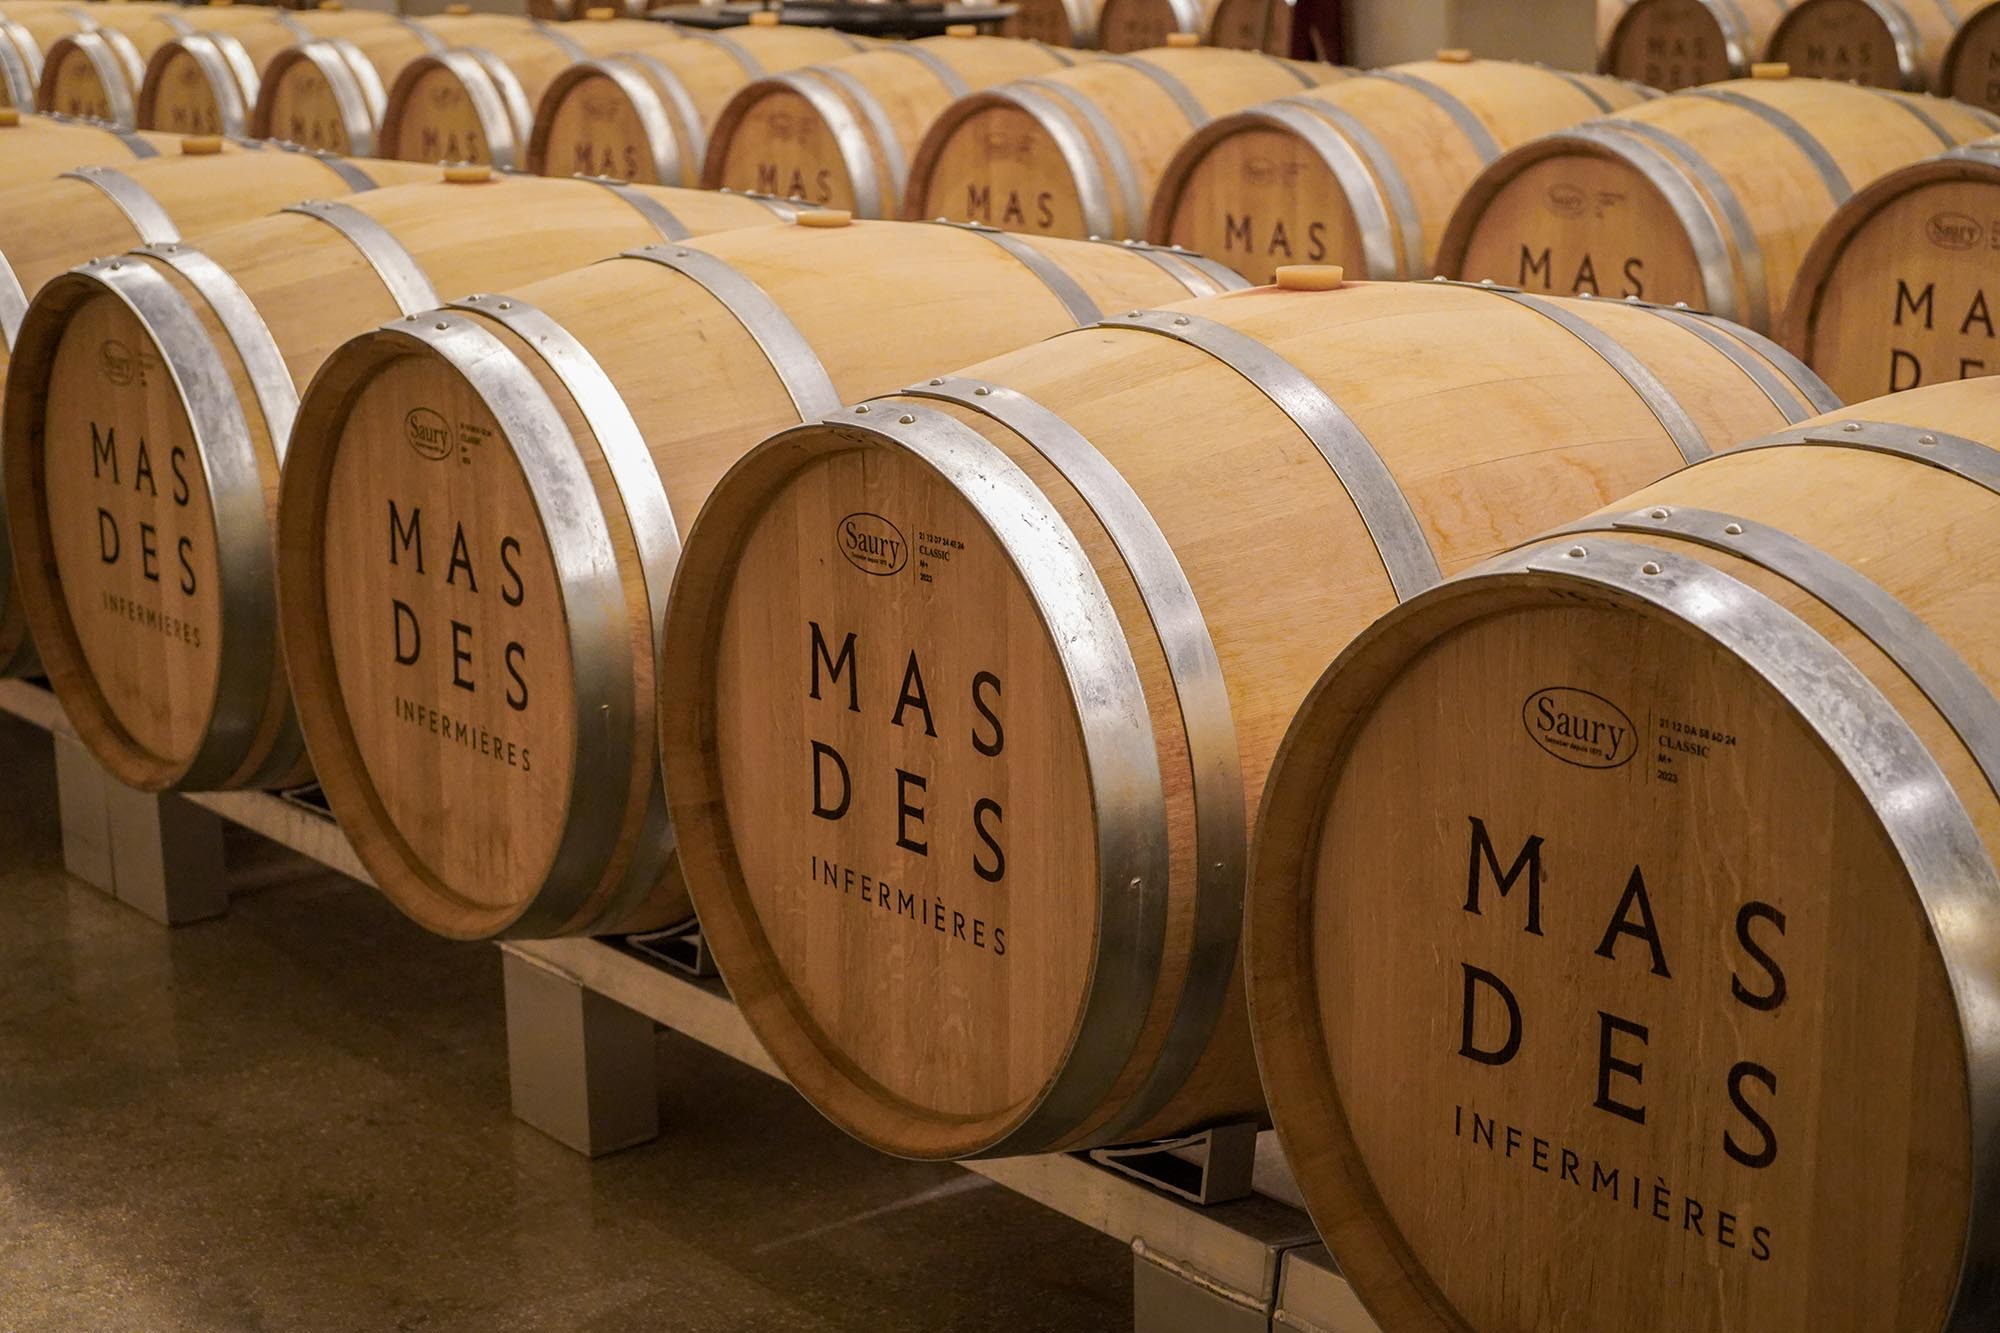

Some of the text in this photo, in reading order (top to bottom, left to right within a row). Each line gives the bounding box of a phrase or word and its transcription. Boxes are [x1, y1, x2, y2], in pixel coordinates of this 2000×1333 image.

[422, 126, 479, 163] MAS
[574, 142, 639, 179] MAS
[758, 163, 833, 203] MAS
[966, 183, 1054, 229] MAS
[1224, 211, 1327, 262] MAS
[1519, 243, 1643, 300] MAS
[90, 421, 189, 508] MAS
[97, 506, 196, 596] DES
[388, 500, 525, 607] MAS
[845, 521, 900, 569] Saury
[919, 545, 950, 562] CLASSIC
[392, 600, 529, 712] DES
[808, 621, 1005, 757] MAS
[395, 696, 532, 773] INFERMIÈRES
[1537, 696, 1626, 761] Saury
[1659, 735, 1710, 759] CLASSIC
[810, 739, 1006, 883] DES
[811, 856, 1006, 956] INFERMIÈRES
[1462, 815, 1788, 1012] MAS
[1458, 962, 1778, 1169] DES
[1455, 1105, 1771, 1262] INFERMIÈRES
